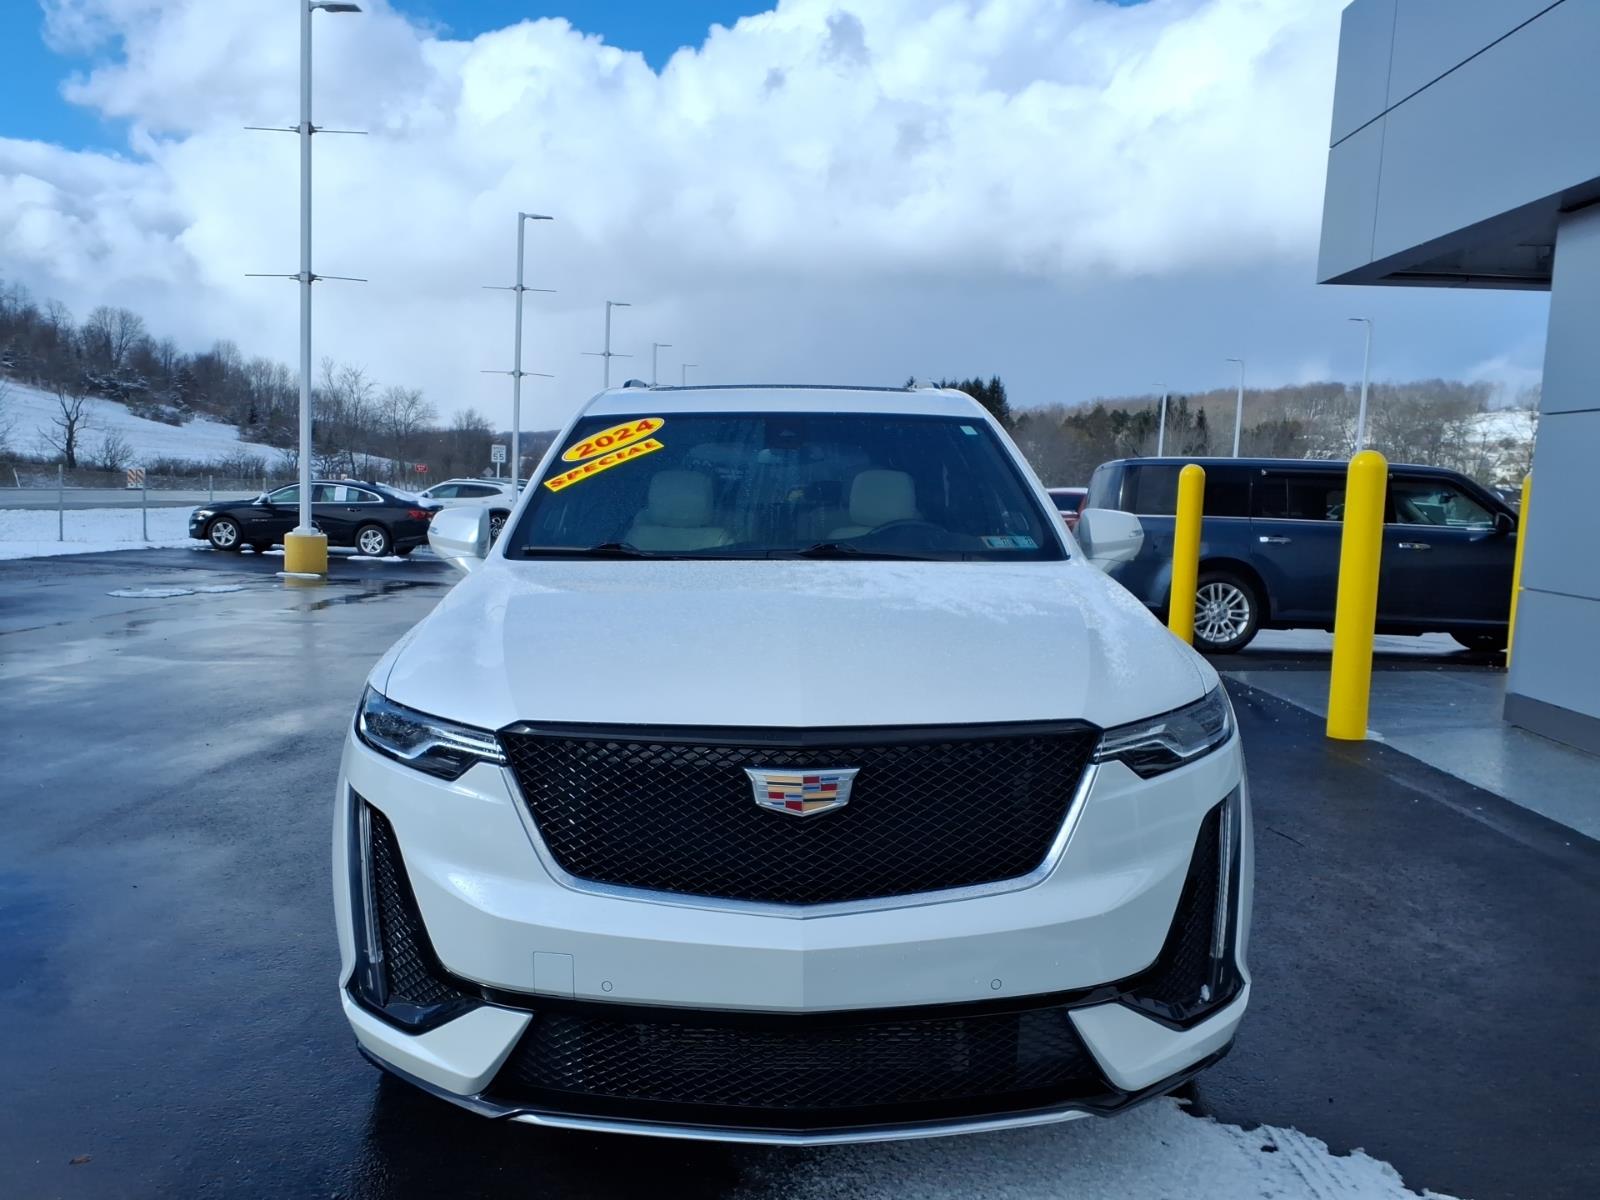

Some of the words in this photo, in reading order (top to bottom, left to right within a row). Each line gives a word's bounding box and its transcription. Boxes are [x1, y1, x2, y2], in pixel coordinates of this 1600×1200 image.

[493, 453, 505, 461] 55
[576, 420, 654, 458] 2024
[550, 441, 657, 488] SPECIAL
